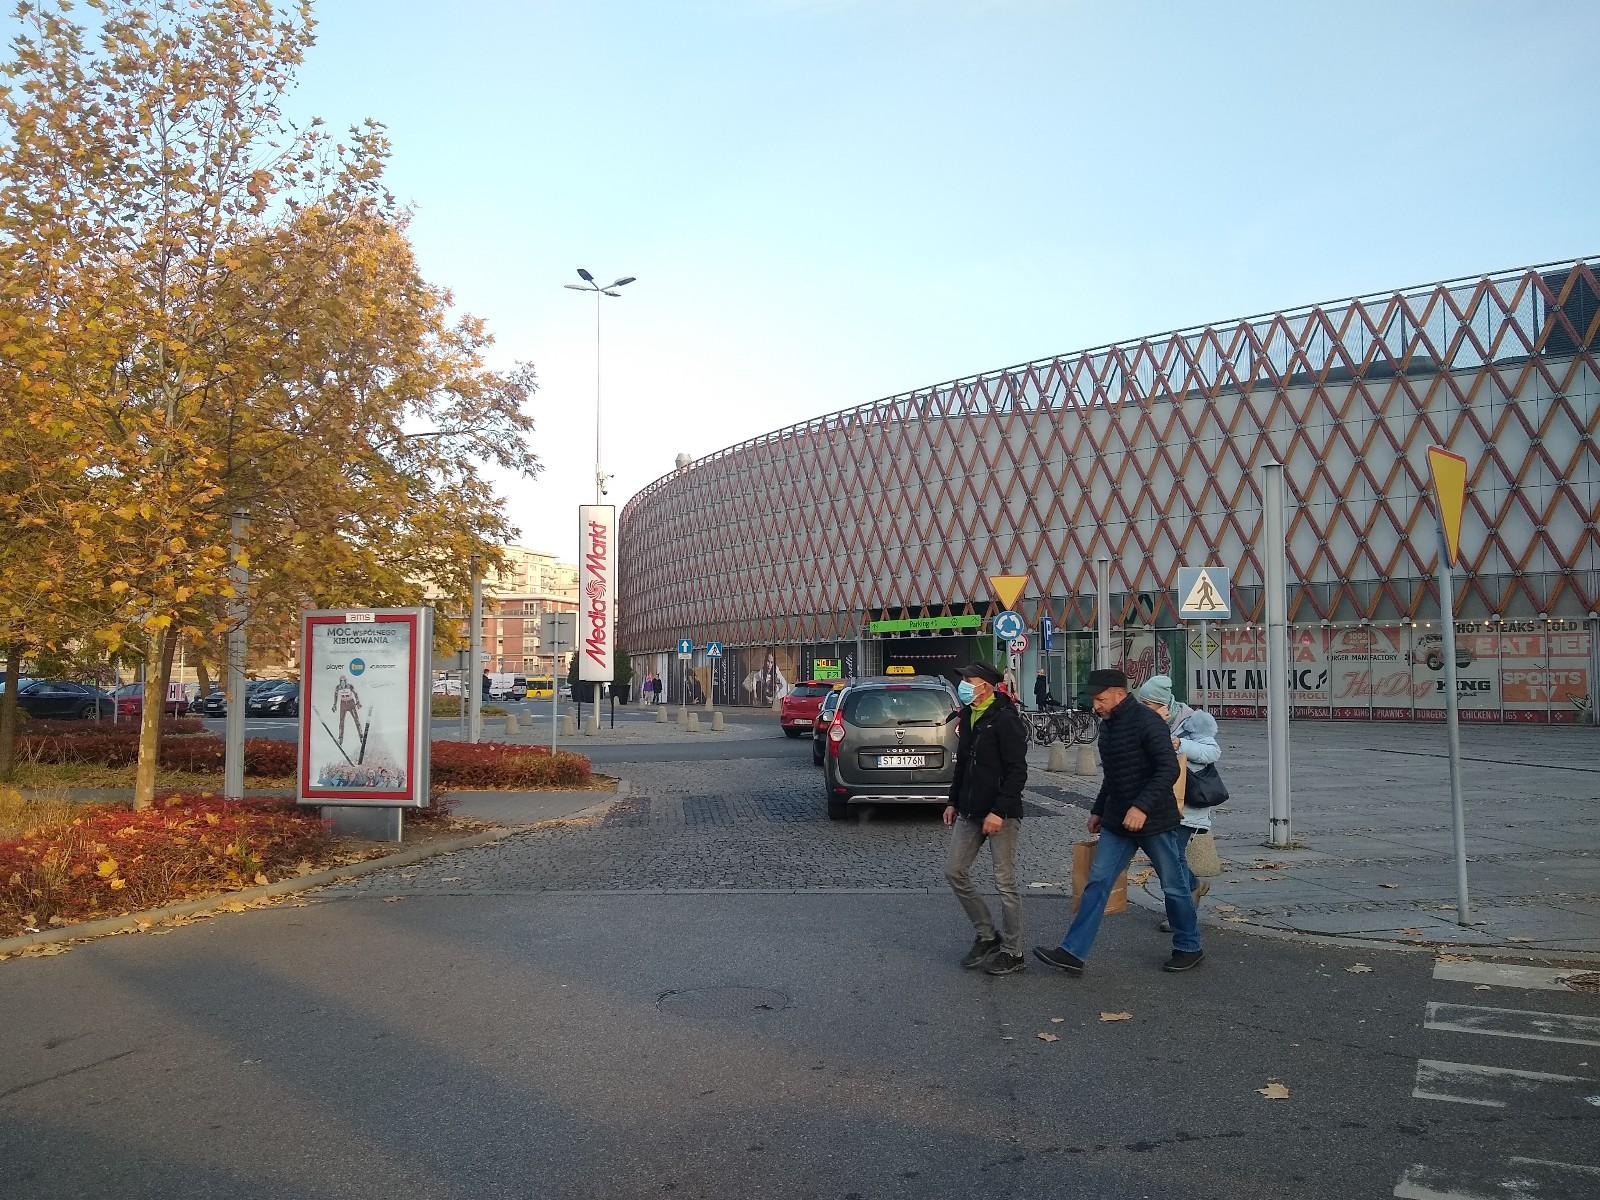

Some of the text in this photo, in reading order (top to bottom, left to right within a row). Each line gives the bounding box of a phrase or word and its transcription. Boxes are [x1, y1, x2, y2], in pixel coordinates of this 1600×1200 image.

[350, 613, 371, 621] ams
[909, 621, 930, 629] Parking
[1457, 623, 1482, 634] HOT
[1486, 621, 1536, 634] STEAKS
[327, 627, 351, 637] MOC
[333, 636, 388, 645] KIBICOWANIA
[1475, 636, 1532, 655] EAT
[1503, 672, 1581, 685] SPORTS
[1526, 686, 1558, 700] TV
[1462, 711, 1491, 719] CHICKEN
[883, 756, 923, 765] ST 3176N
